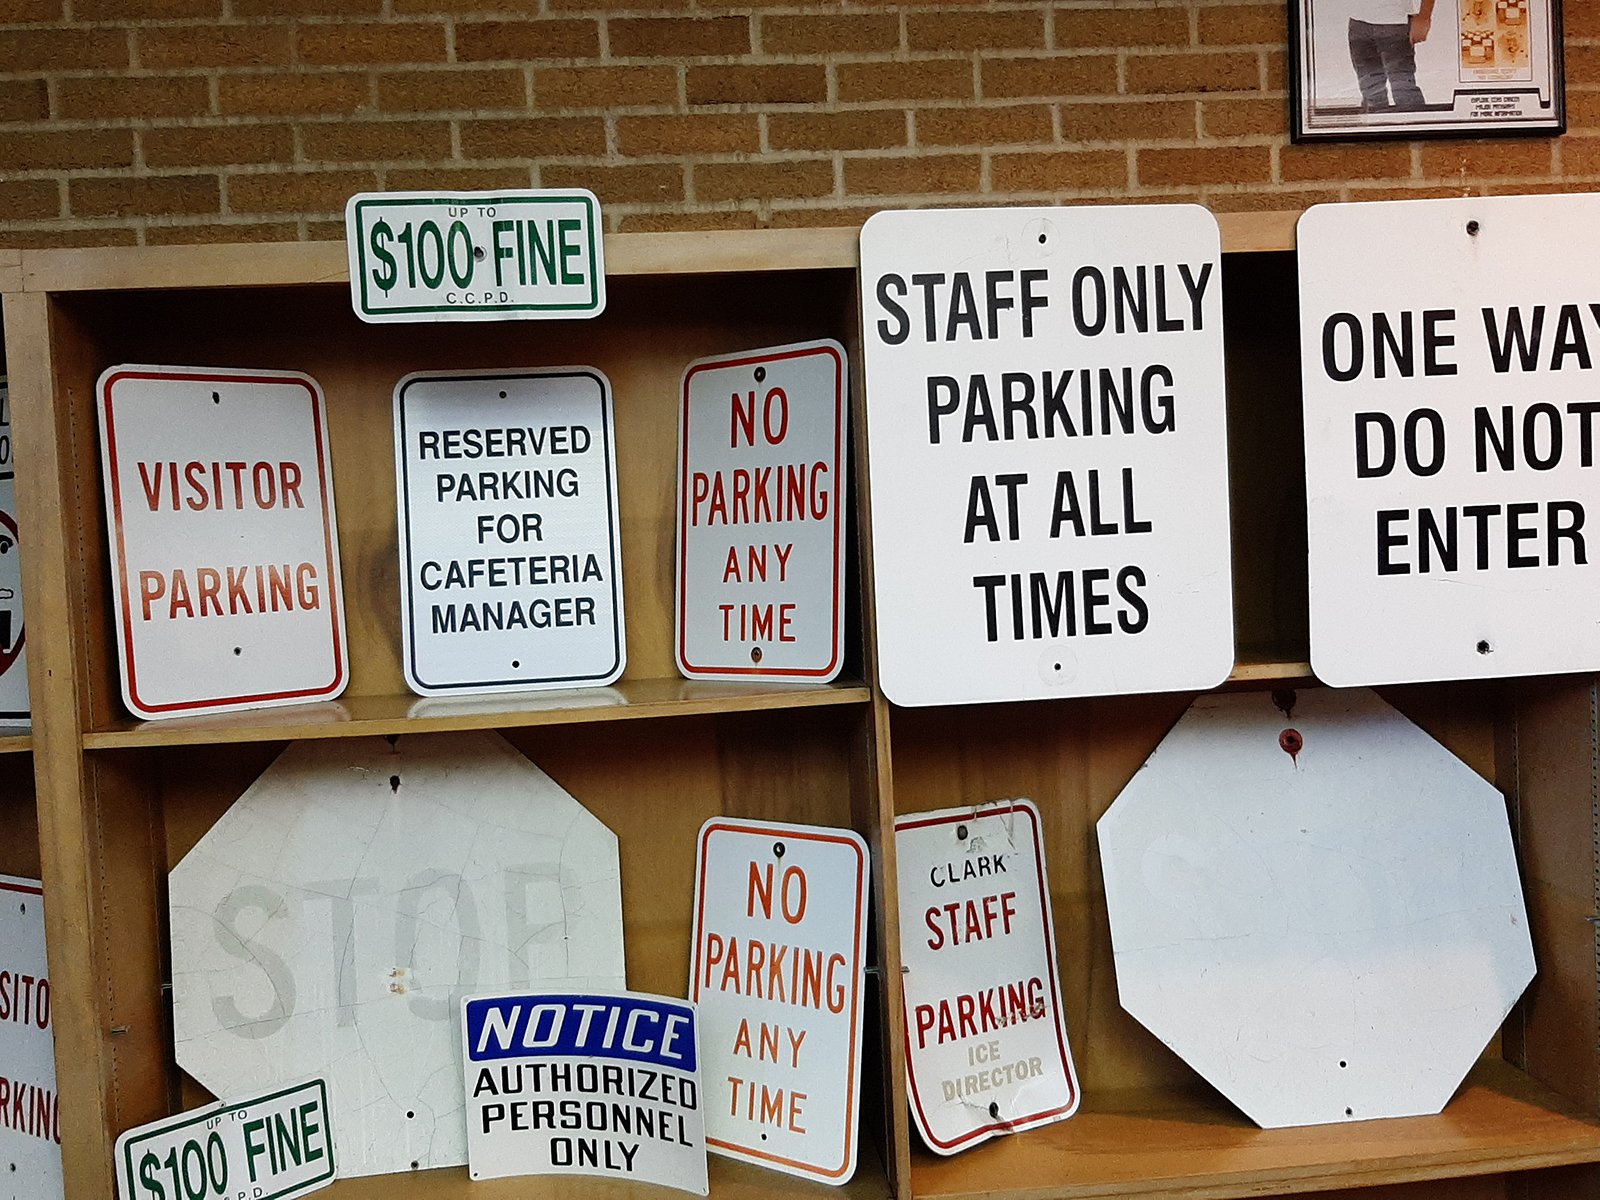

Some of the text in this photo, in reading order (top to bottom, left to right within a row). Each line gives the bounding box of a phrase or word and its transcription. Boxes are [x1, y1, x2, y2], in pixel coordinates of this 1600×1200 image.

[449, 207, 497, 218] UP TO
[370, 216, 585, 298] $100 FINE
[446, 291, 514, 305] C.C.P.D.
[876, 263, 1213, 345] STAFF ONLY
[1322, 303, 1600, 382] ONE WA
[731, 386, 788, 448] NO
[926, 363, 1176, 445] PARKING
[419, 425, 591, 460] RESERVED
[1354, 402, 1600, 479] DO NOT
[137, 461, 305, 512] VISITOR
[436, 468, 579, 502] PARKING
[692, 461, 829, 527] PARKING
[963, 467, 1153, 544] AT ALL
[477, 513, 543, 544] FOR
[1376, 500, 1589, 576] ENTER
[420, 553, 603, 590] CAFETERIA
[723, 543, 793, 583] ANY
[139, 562, 320, 621] PARKING
[431, 597, 596, 634] MANAGER
[973, 565, 1149, 643] TIMES
[719, 603, 796, 642] TIME
[747, 860, 807, 924] NO
[930, 853, 1008, 888] CLARK
[925, 892, 1017, 951] STAFF
[0, 970, 50, 1030] SITO
[704, 932, 847, 1014] PARKING
[476, 1004, 690, 1060] NOTICE
[915, 977, 1047, 1050] PARKING
[733, 1018, 807, 1068] ANY
[968, 1040, 1001, 1067] ICE
[473, 1063, 697, 1110] AUTHORIZED
[728, 1076, 808, 1135] TIME
[942, 1056, 1044, 1102] DIRECTOR
[206, 1110, 248, 1130] UP TO
[481, 1100, 693, 1148] PERSONNEL
[139, 1101, 323, 1200] $100 FINE
[550, 1137, 639, 1172] ONLY
